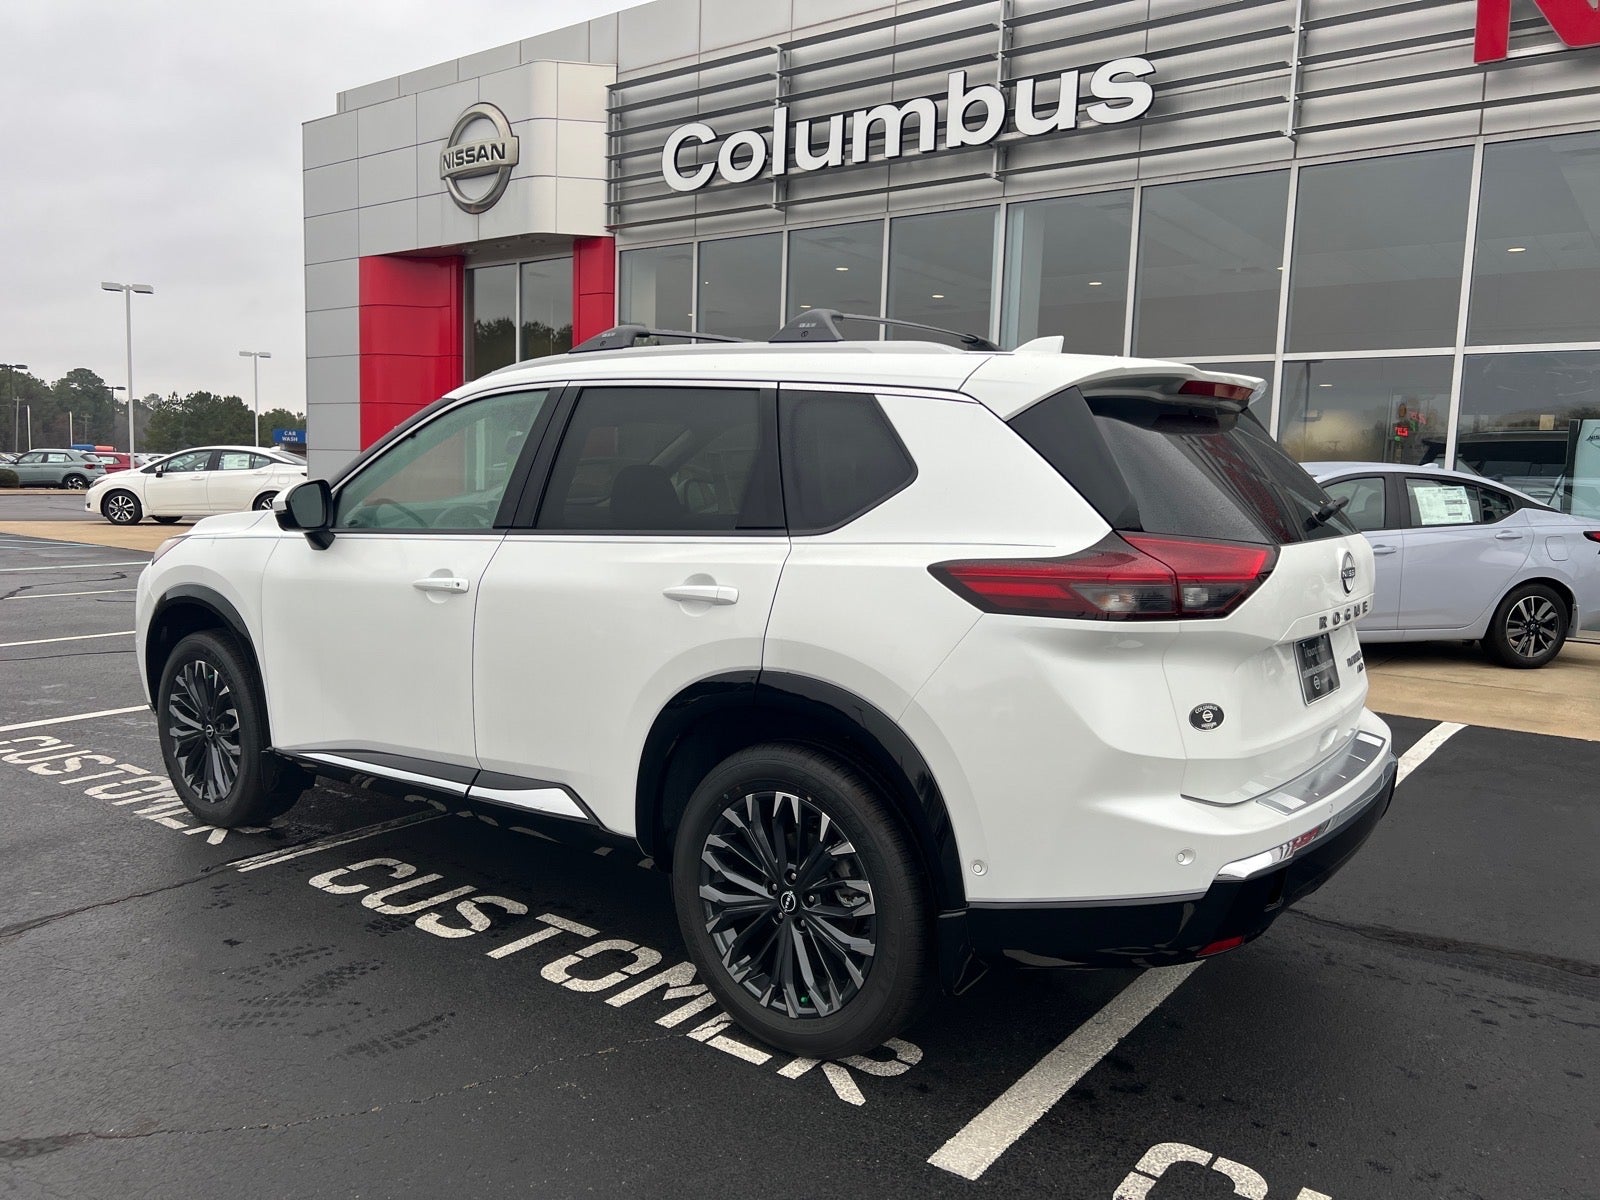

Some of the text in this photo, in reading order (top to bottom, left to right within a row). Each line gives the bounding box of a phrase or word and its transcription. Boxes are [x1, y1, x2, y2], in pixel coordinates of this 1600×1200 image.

[662, 57, 1156, 192] Columbus
[443, 142, 506, 171] NISSAN
[1319, 601, 1368, 630] ROGUE
